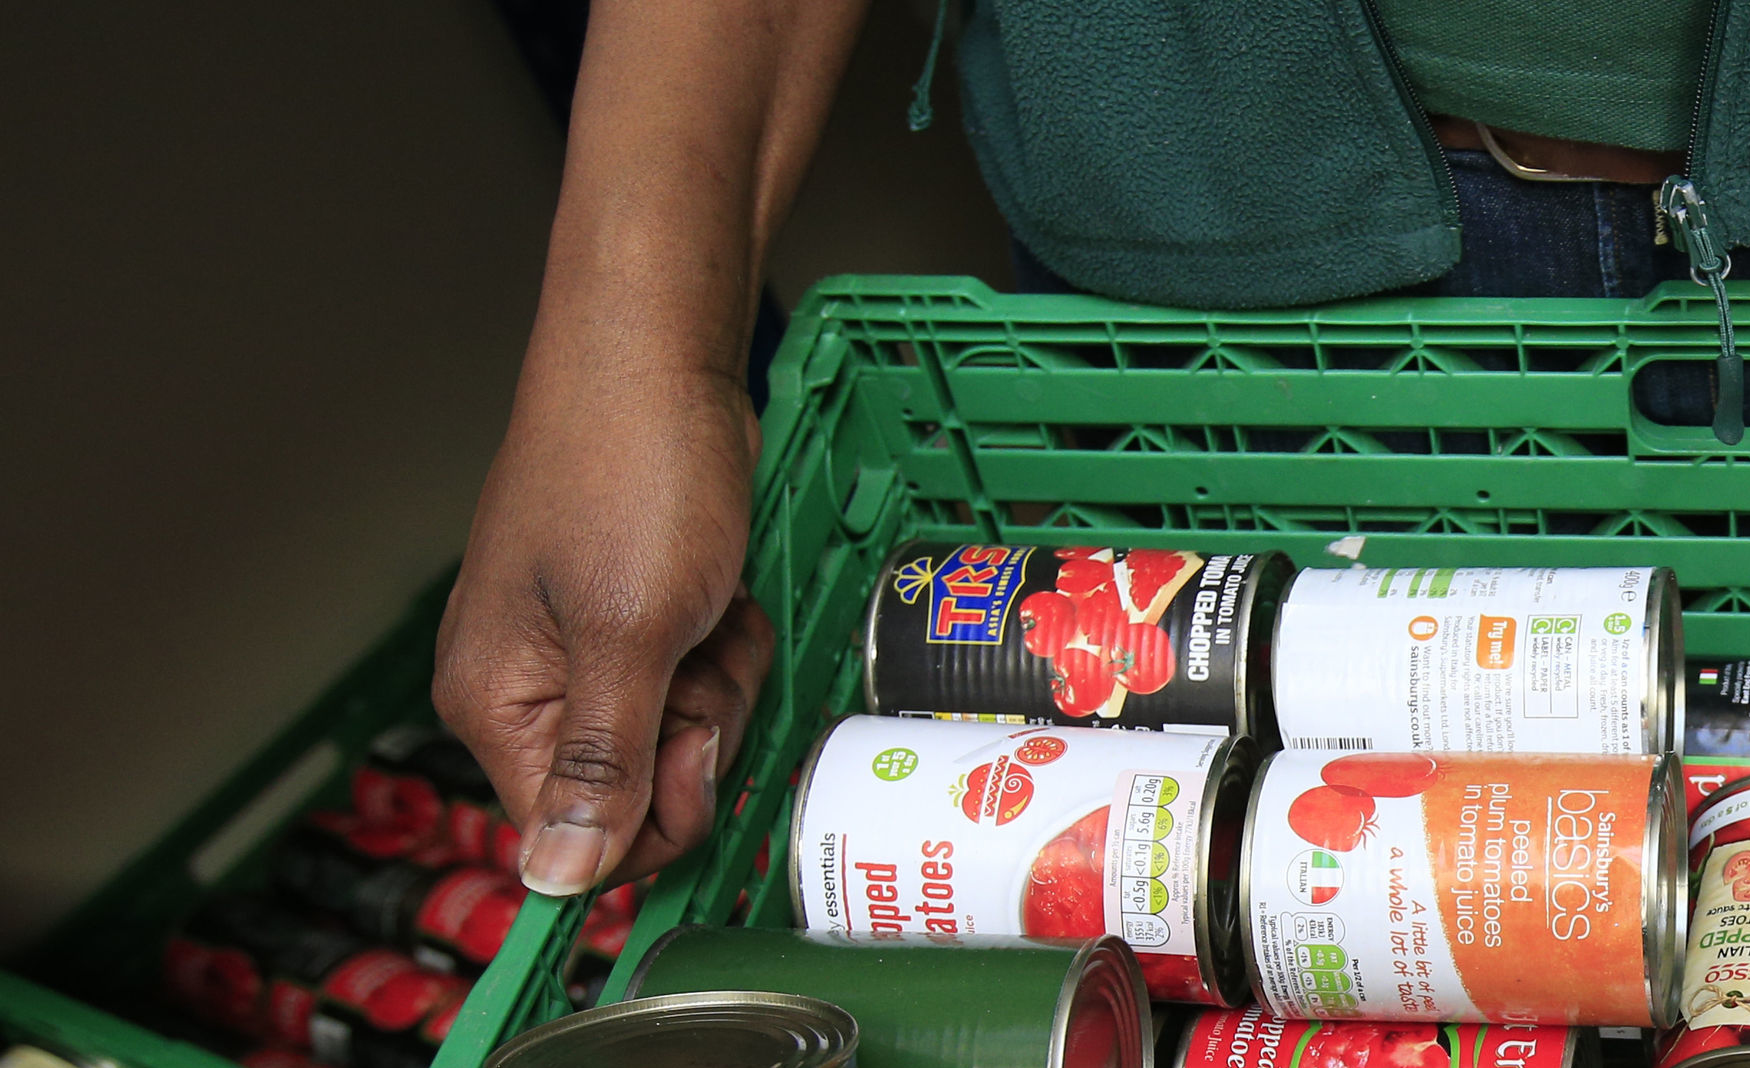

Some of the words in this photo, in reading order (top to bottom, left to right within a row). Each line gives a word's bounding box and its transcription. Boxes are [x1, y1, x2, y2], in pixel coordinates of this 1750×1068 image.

[935, 546, 1011, 636] TRS
[1619, 571, 1641, 588] 400g
[1218, 575, 1242, 625] TOMATO
[1188, 590, 1218, 680] CHOPPED
[1215, 629, 1231, 644] IN
[1488, 621, 1508, 638] Try
[1489, 641, 1504, 664] me!
[1540, 636, 1549, 658] LABEL
[1564, 636, 1573, 654] CAN
[1422, 646, 1432, 669] Want
[1423, 672, 1431, 681] to
[1540, 668, 1549, 693] PAPER
[1563, 663, 1572, 690] METAL
[1621, 670, 1629, 687] can
[1407, 646, 1423, 748] sainsburys.co.uk
[1422, 684, 1432, 702] find
[1621, 689, 1630, 720] counts
[1423, 704, 1431, 720] out
[1611, 707, 1620, 741] different
[1424, 723, 1434, 750] more?
[1621, 723, 1629, 733] as
[891, 752, 906, 760] 5
[1622, 741, 1631, 750] of
[1141, 779, 1161, 803] 0.20g
[1162, 785, 1174, 796] 3%
[1463, 784, 1487, 800] in
[1486, 783, 1512, 831] plum
[1136, 812, 1154, 834] 5.6g
[1390, 847, 1405, 860] a
[1456, 804, 1483, 883] tomato
[1134, 843, 1151, 876] <0.1g
[1154, 852, 1165, 872] <1%
[1508, 819, 1534, 902] peeled
[1551, 789, 1609, 941] basics
[1592, 811, 1616, 913] Sainsbury's
[820, 832, 839, 917] essentials
[1299, 861, 1308, 893] ITALIAN
[1133, 880, 1149, 912] <0.5g
[1153, 887, 1163, 906] <1%
[1388, 868, 1408, 923] whole
[1483, 838, 1505, 948] tomatoes
[1411, 900, 1427, 915] A
[1451, 887, 1479, 945] juice
[1706, 905, 1735, 917] sauce
[1259, 915, 1270, 943] Reference
[1269, 915, 1279, 939] Typical
[1326, 917, 1334, 942] ENERGY
[1411, 922, 1429, 956] little
[1390, 931, 1410, 955] lot
[1393, 961, 1414, 977] of
[1415, 960, 1433, 978] bit
[1419, 981, 1434, 993] of
[1204, 1035, 1222, 1061] Juice
